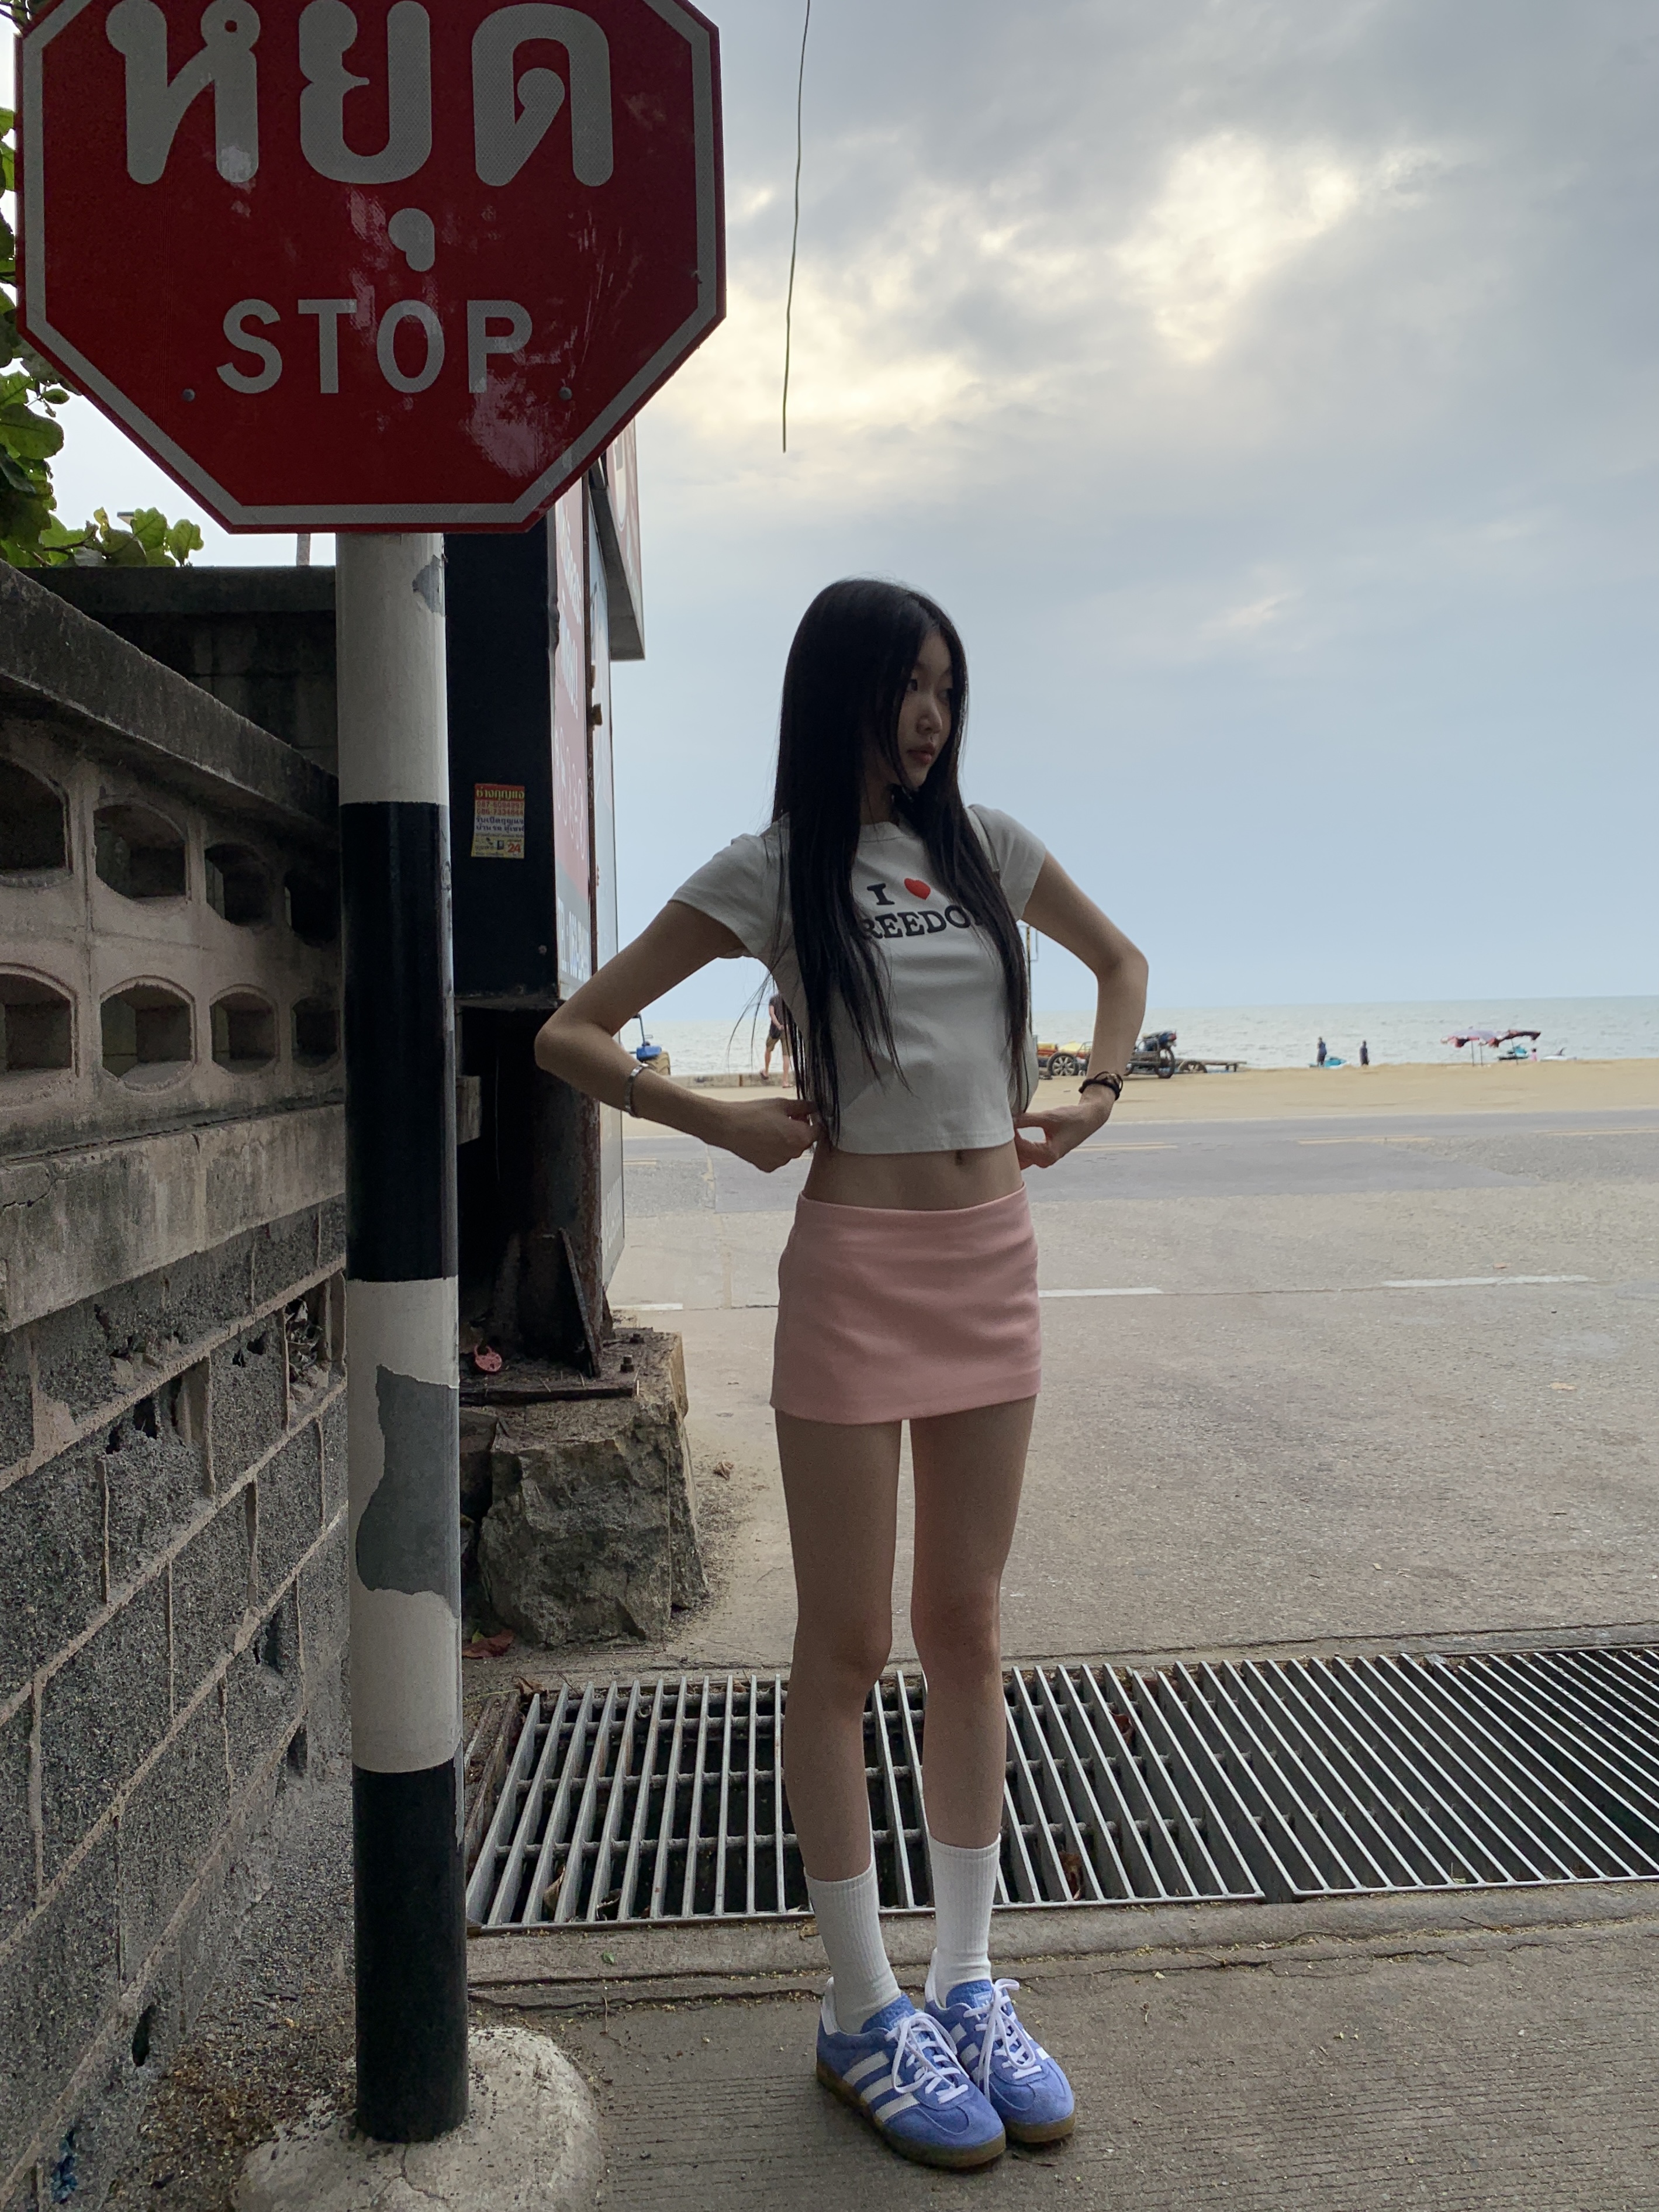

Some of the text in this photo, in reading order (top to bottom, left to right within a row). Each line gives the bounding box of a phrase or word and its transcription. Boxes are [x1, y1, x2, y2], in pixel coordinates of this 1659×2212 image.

[106, 0, 614, 272] หยุด
[216, 299, 533, 393] STOP
[507, 842, 521, 853] 24
[867, 883, 895, 905] I
